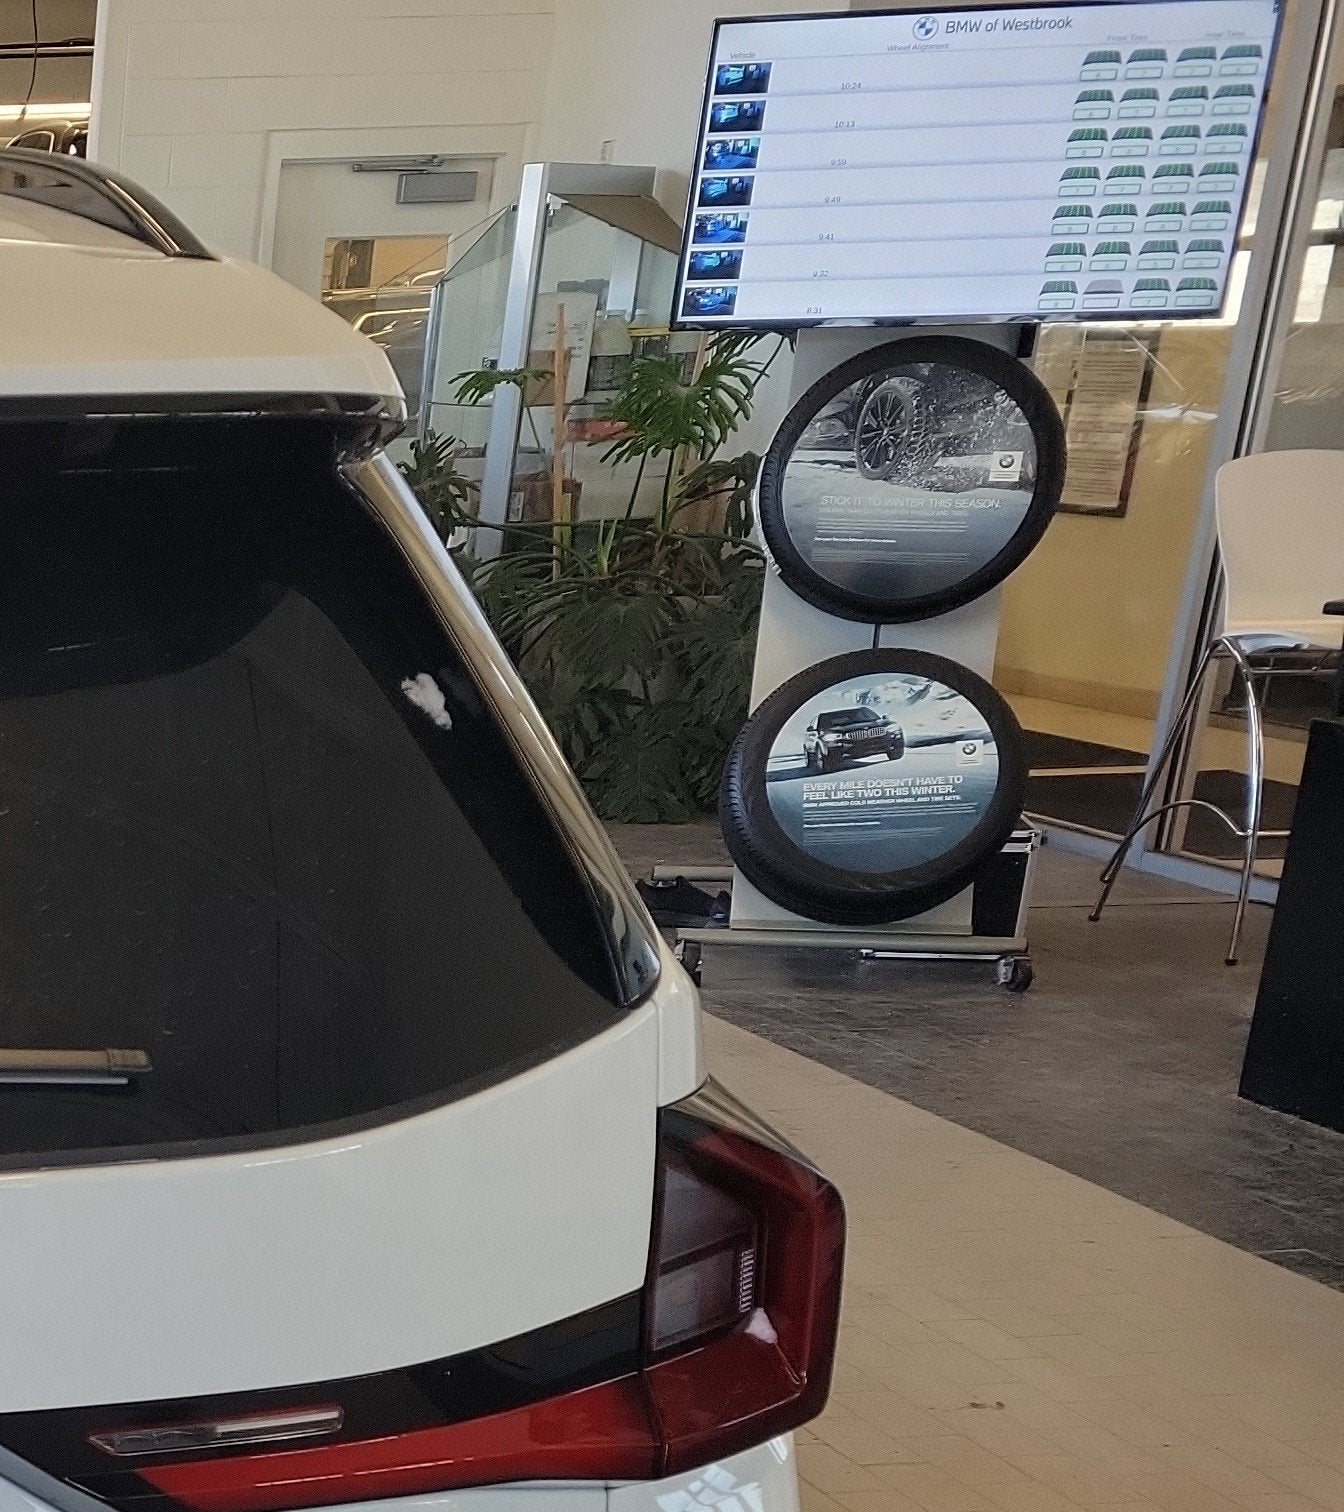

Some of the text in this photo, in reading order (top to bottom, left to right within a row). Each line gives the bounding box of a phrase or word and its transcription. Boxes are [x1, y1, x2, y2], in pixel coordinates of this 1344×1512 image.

[945, 19, 982, 34] BMW
[985, 18, 999, 32] of
[1002, 15, 1074, 31] Westbrook
[821, 495, 850, 506] STICK
[929, 498, 952, 508] THIS
[955, 498, 1002, 509] SEASON.
[803, 775, 964, 792] EVERY MILE DOESN'T HAVE TO
[803, 784, 956, 801] FEEL LIKE TWO THIS WINTER.
